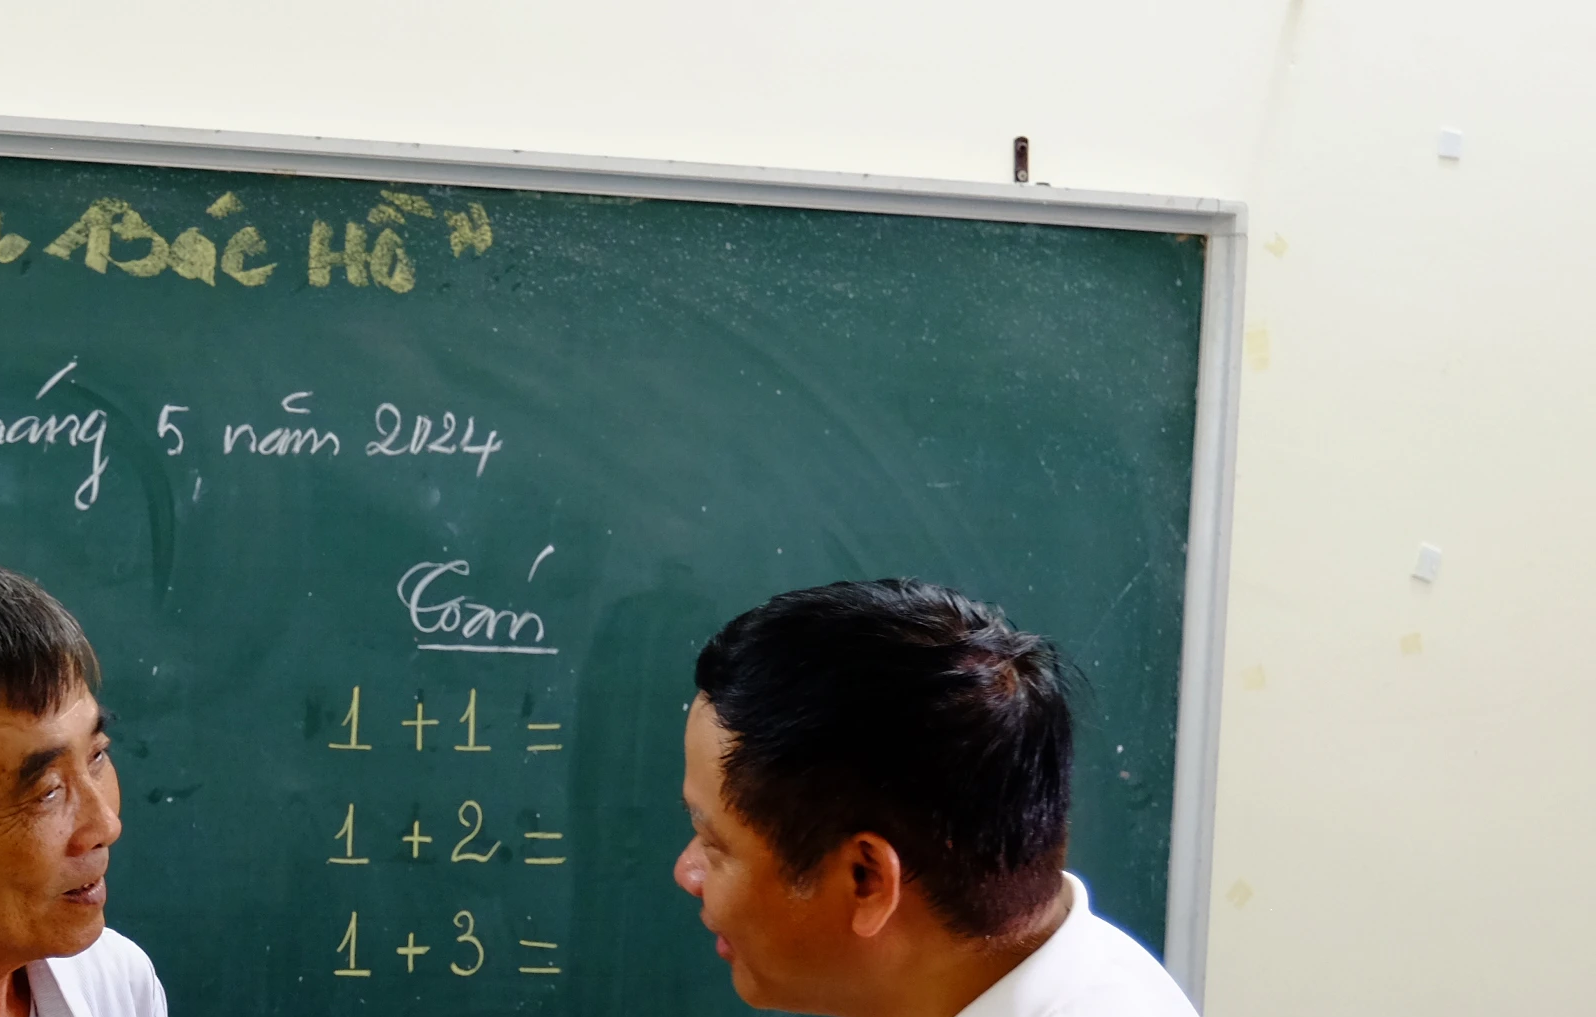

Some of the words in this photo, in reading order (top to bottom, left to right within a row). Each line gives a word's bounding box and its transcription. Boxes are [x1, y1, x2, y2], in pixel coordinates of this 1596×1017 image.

[44, 192, 277, 286] Bác
[158, 404, 188, 455] 5
[224, 392, 340, 455] năm
[367, 403, 502, 476] 2024
[397, 544, 555, 642] Toán
[329, 686, 372, 750] 1
[454, 688, 491, 751] 1
[327, 803, 369, 864] 1
[451, 800, 501, 862] 2
[334, 911, 371, 976] 1
[451, 910, 484, 976] 3
